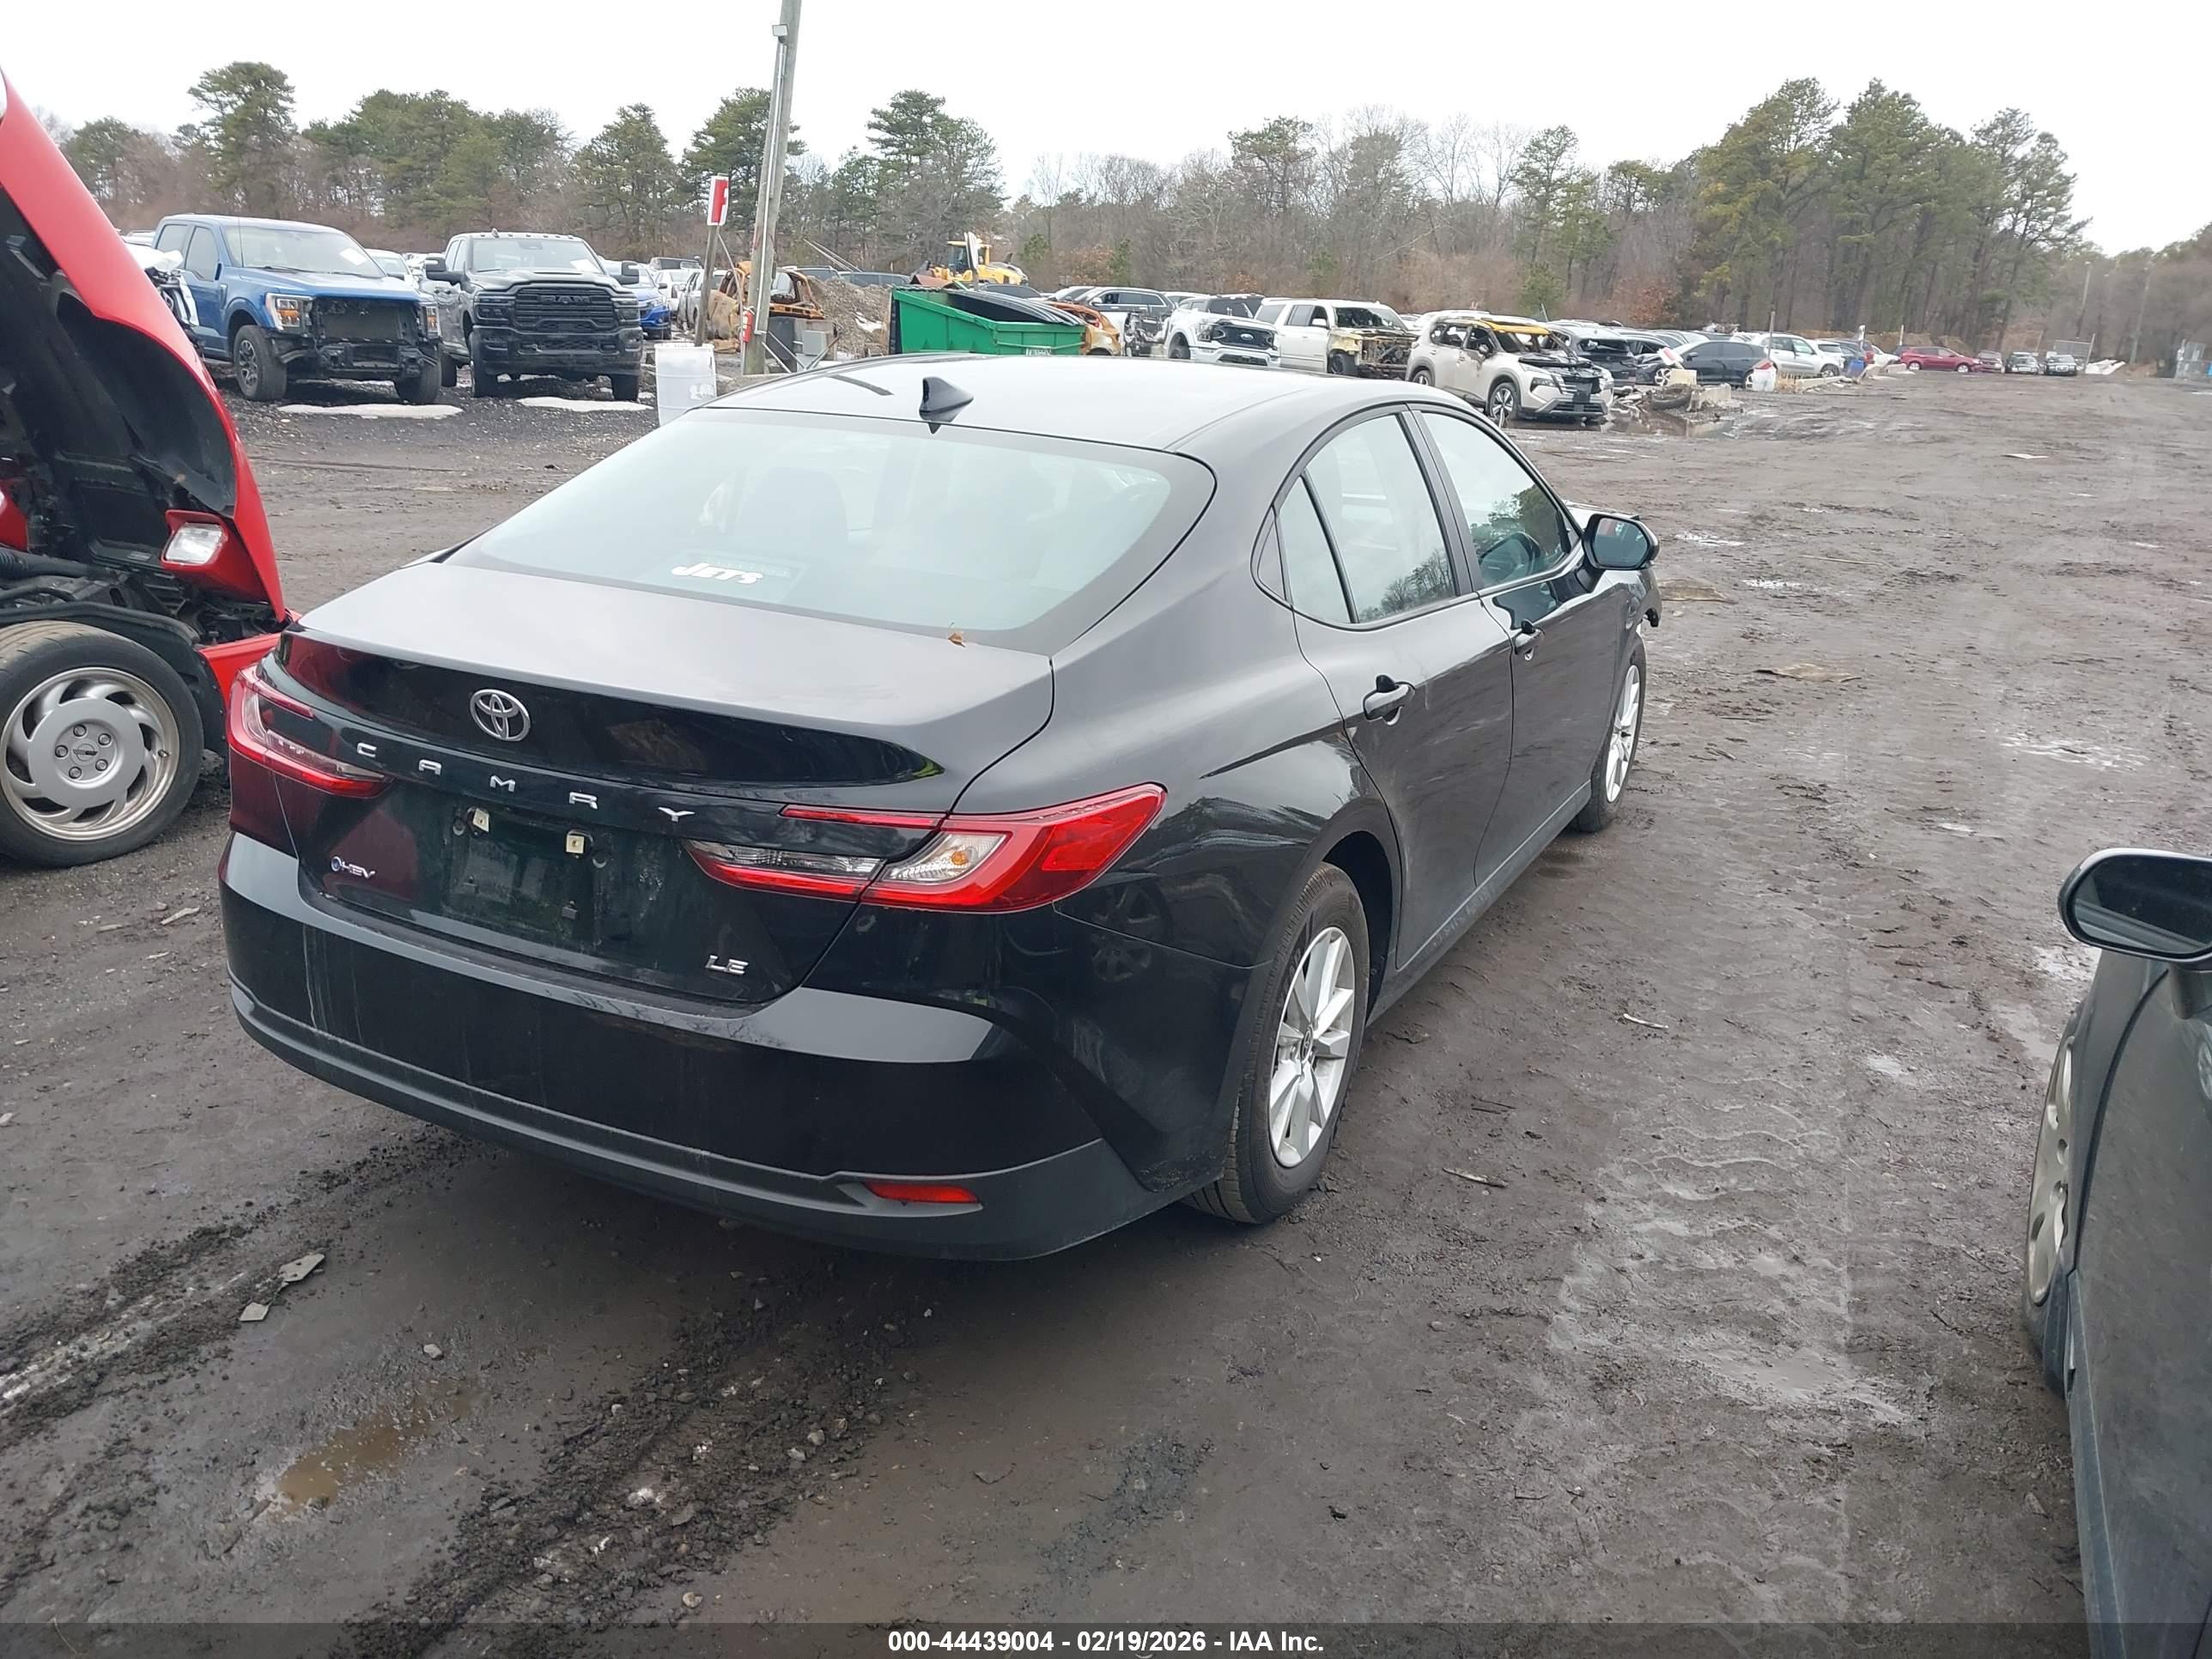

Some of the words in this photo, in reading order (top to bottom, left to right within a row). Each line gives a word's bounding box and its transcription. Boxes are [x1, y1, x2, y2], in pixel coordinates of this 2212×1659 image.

[540, 295, 591, 303] RAM
[671, 562, 763, 585] JETS
[357, 742, 695, 822] CAMRY
[705, 955, 749, 975] LE
